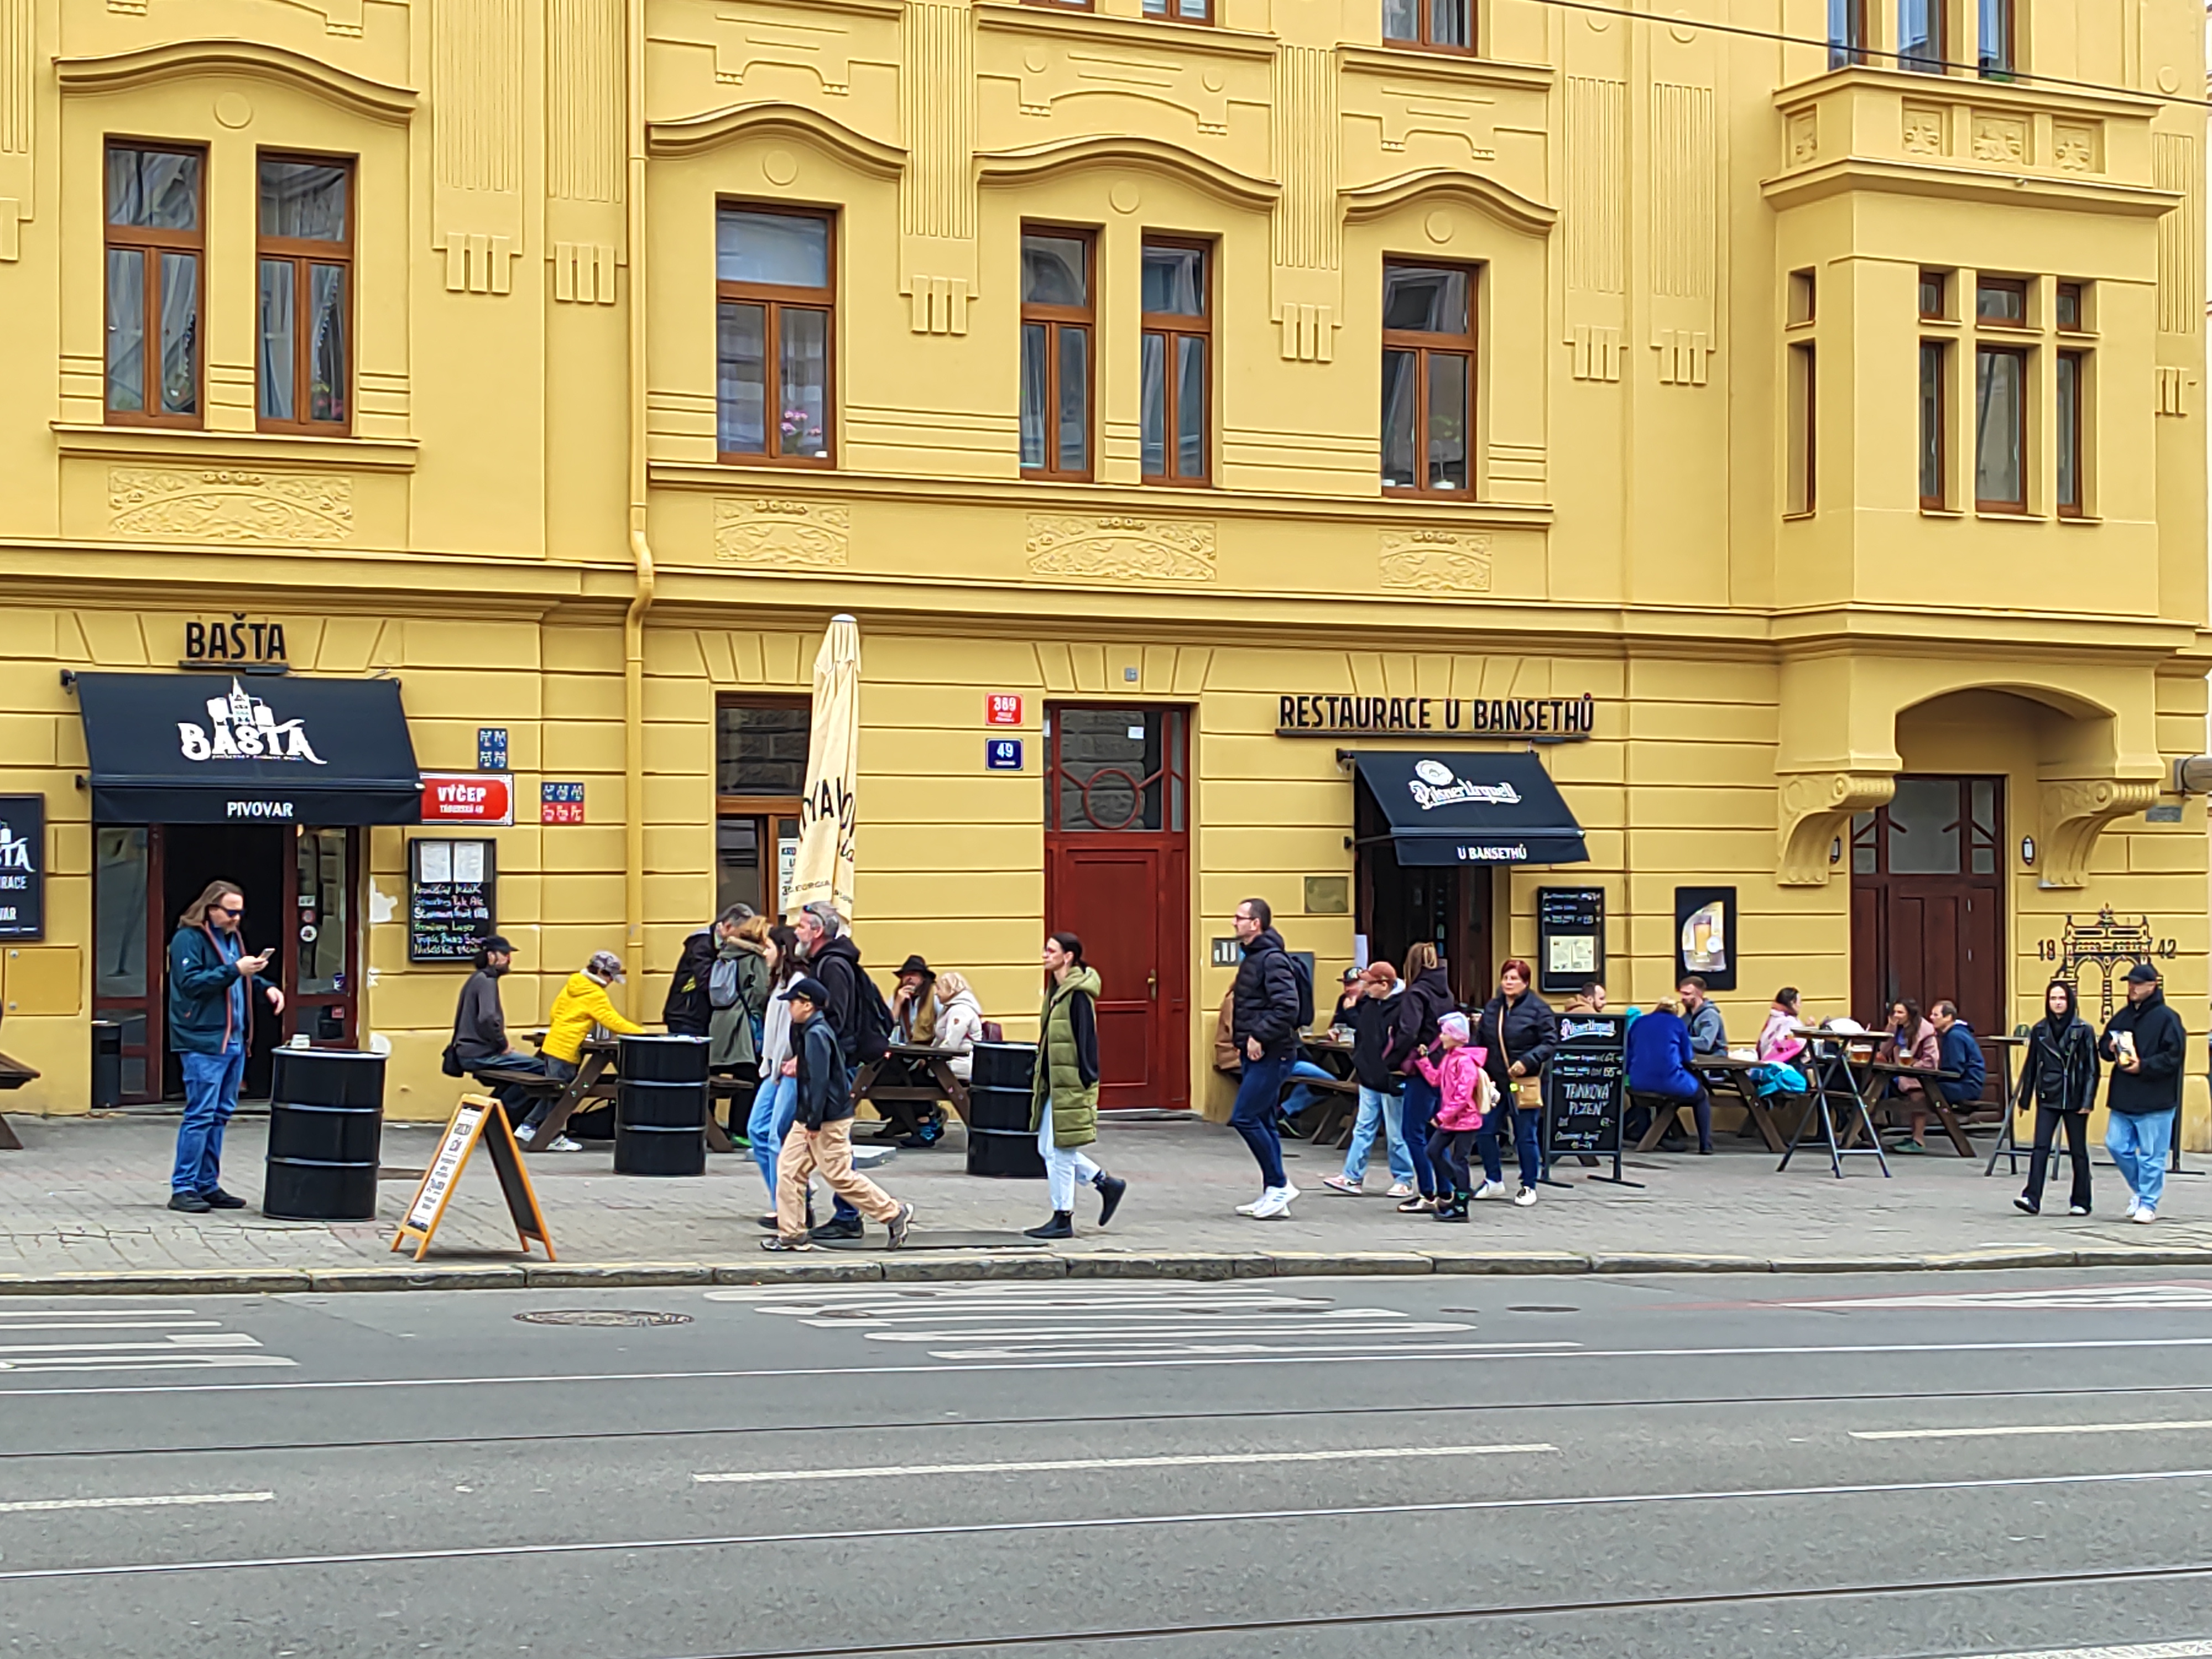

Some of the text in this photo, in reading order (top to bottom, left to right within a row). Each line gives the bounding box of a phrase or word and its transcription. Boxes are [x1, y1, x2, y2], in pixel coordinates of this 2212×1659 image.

[186, 613, 286, 660] BAŠTA
[993, 697, 1016, 711] 389
[1280, 692, 1594, 732] RESTAURACE U BANSETHŮ
[997, 743, 1014, 758] 49
[437, 784, 487, 802] VÝČEP
[1408, 778, 1522, 810] Pilsner Urquell
[227, 801, 294, 818] PIVOVAR
[1457, 843, 1528, 860] U BANSETHŮ
[2158, 938, 2177, 959] 42
